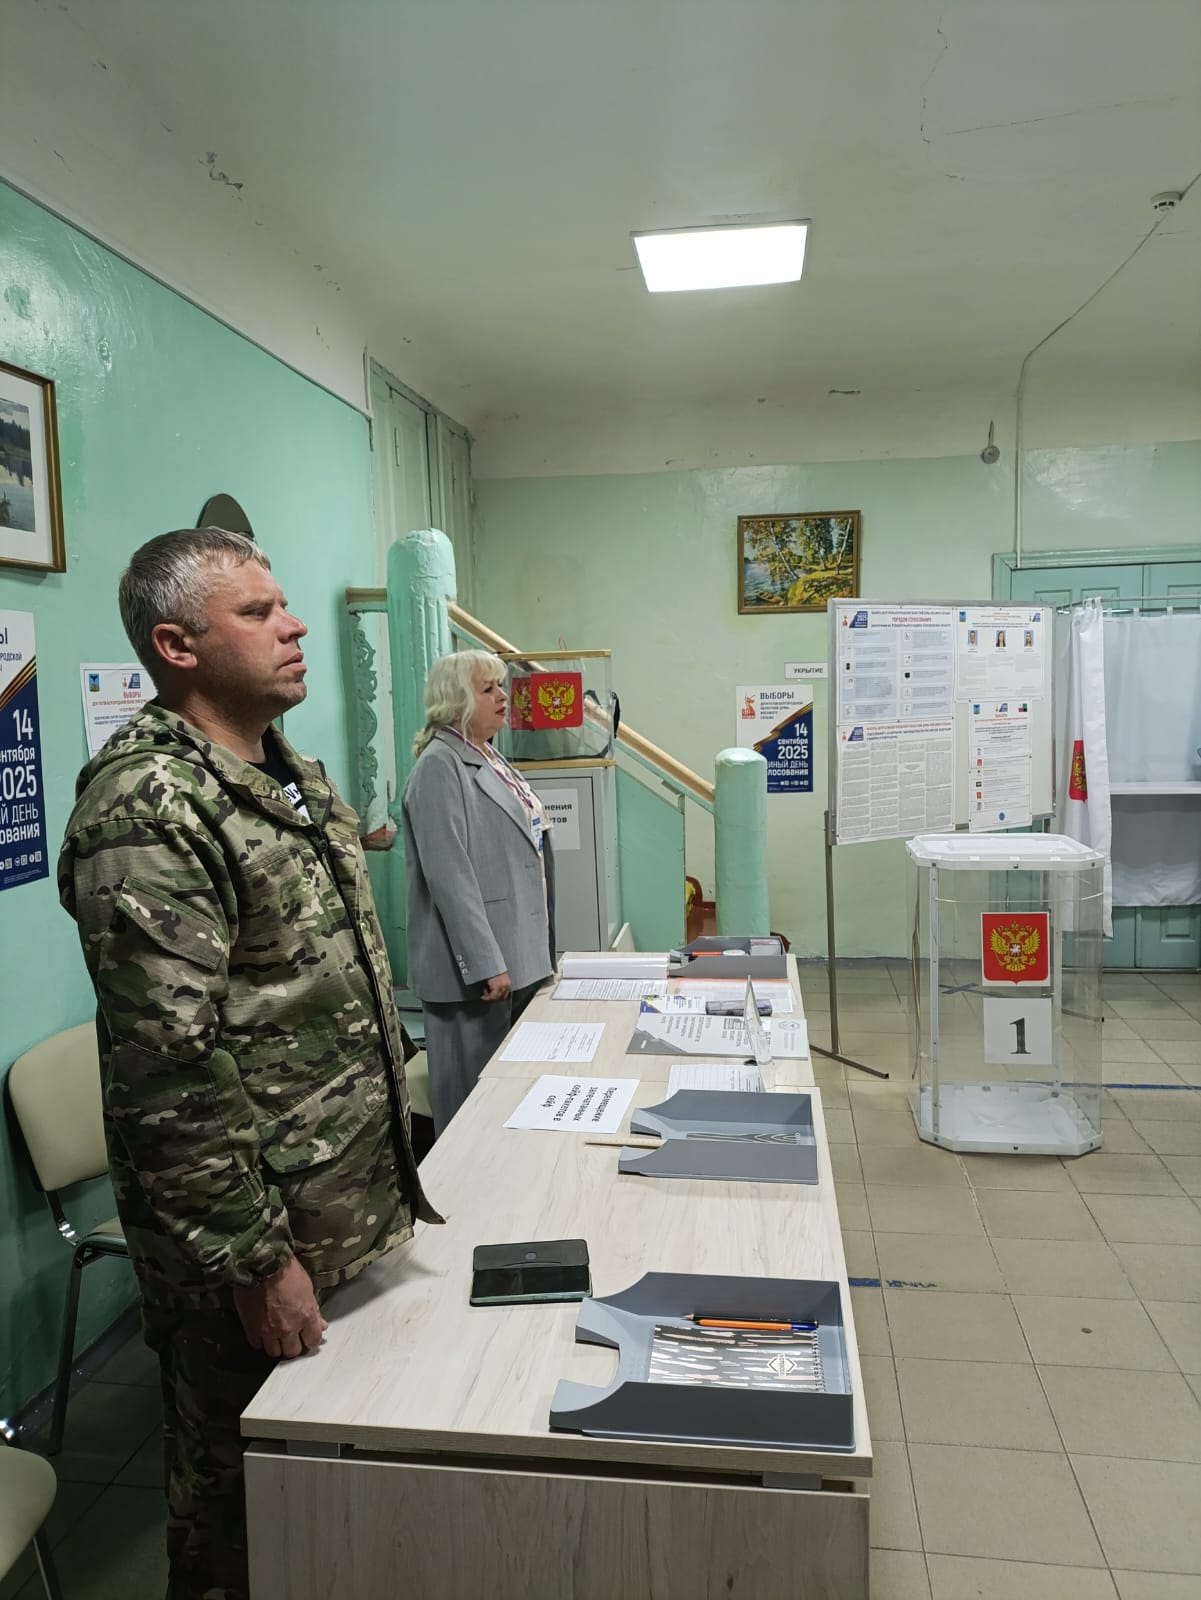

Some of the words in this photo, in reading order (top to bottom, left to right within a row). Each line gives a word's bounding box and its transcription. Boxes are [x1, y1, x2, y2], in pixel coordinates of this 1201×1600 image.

[759, 691, 795, 700] ВЫБОРЫ
[12, 708, 34, 742] 14
[794, 722, 809, 737] 14
[777, 737, 809, 746] сентября
[777, 745, 809, 760] 2025
[789, 760, 809, 769] ДЕНЬ
[11, 802, 39, 826] ДЕНЬ
[1009, 1017, 1032, 1055] 1
[540, 1095, 557, 1108] сейф
[573, 1086, 599, 1121] запечатанных
[591, 1086, 618, 1122] Перемещение
